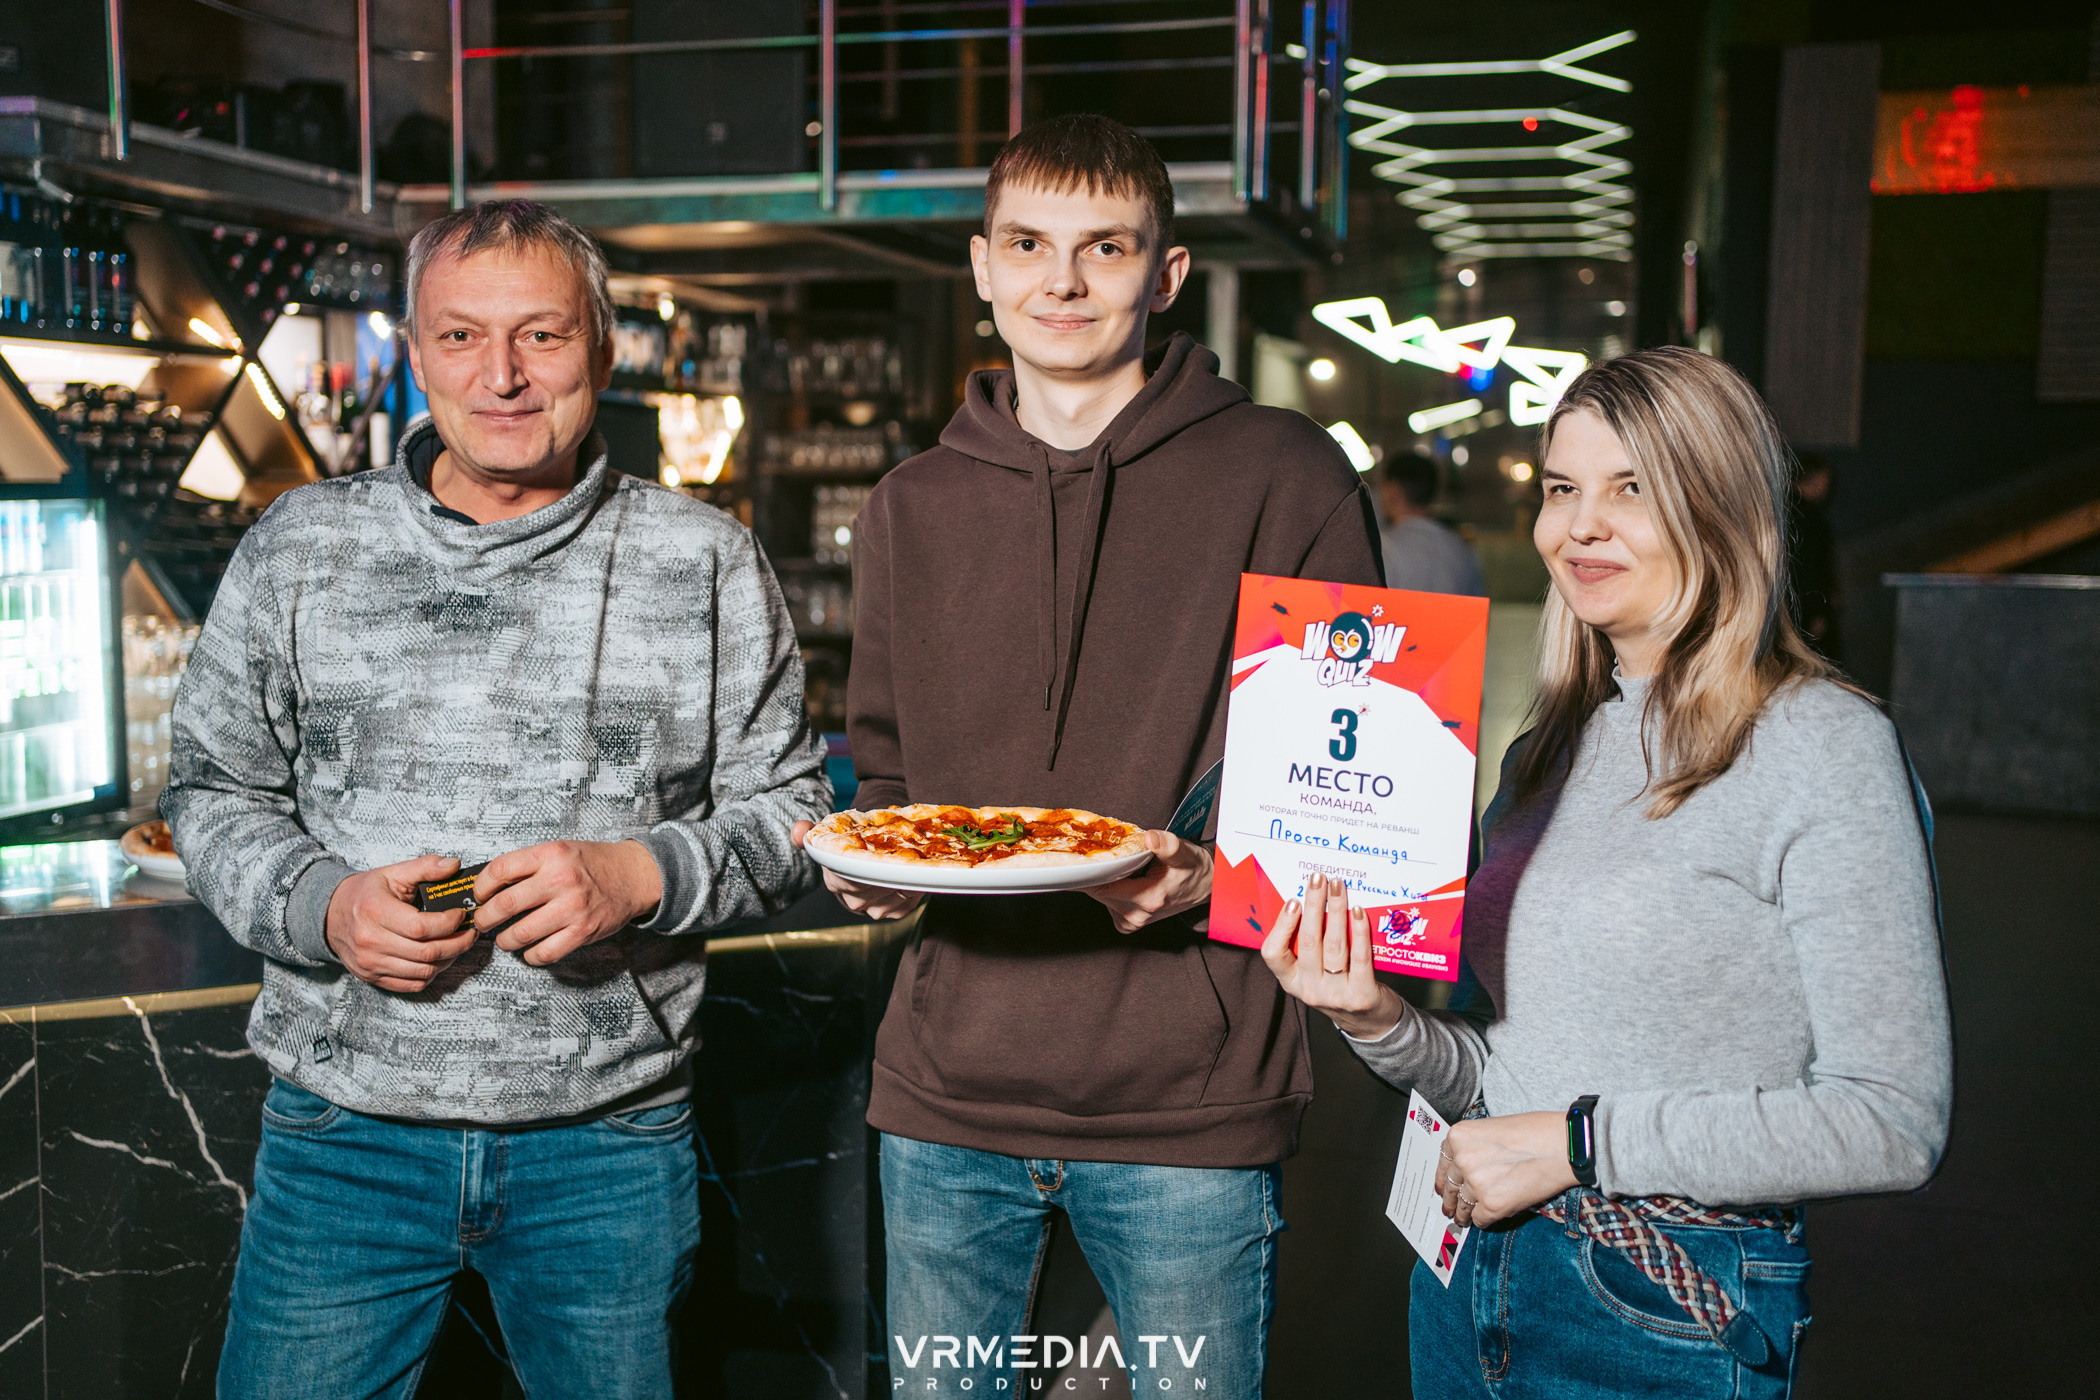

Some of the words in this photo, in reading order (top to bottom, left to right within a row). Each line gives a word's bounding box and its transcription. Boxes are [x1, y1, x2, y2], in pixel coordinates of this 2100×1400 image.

[1300, 612, 1407, 664] WOW
[1316, 655, 1374, 688] QUIZ
[1329, 707, 1358, 761] 3
[1287, 763, 1394, 797] МЕСТО
[1259, 803, 1298, 817] КОТОРАЯ
[1299, 810, 1329, 822] ТОЧНО
[1331, 815, 1364, 828] ПРИДЕТ
[1366, 821, 1379, 830] НА
[1381, 823, 1419, 835] РЕВАНШ
[1299, 792, 1377, 816] КОМАНДА,
[1269, 818, 1330, 846] Просто
[1338, 833, 1408, 865] Команда
[1298, 860, 1367, 879] ПОБЕДИТЕЛИ
